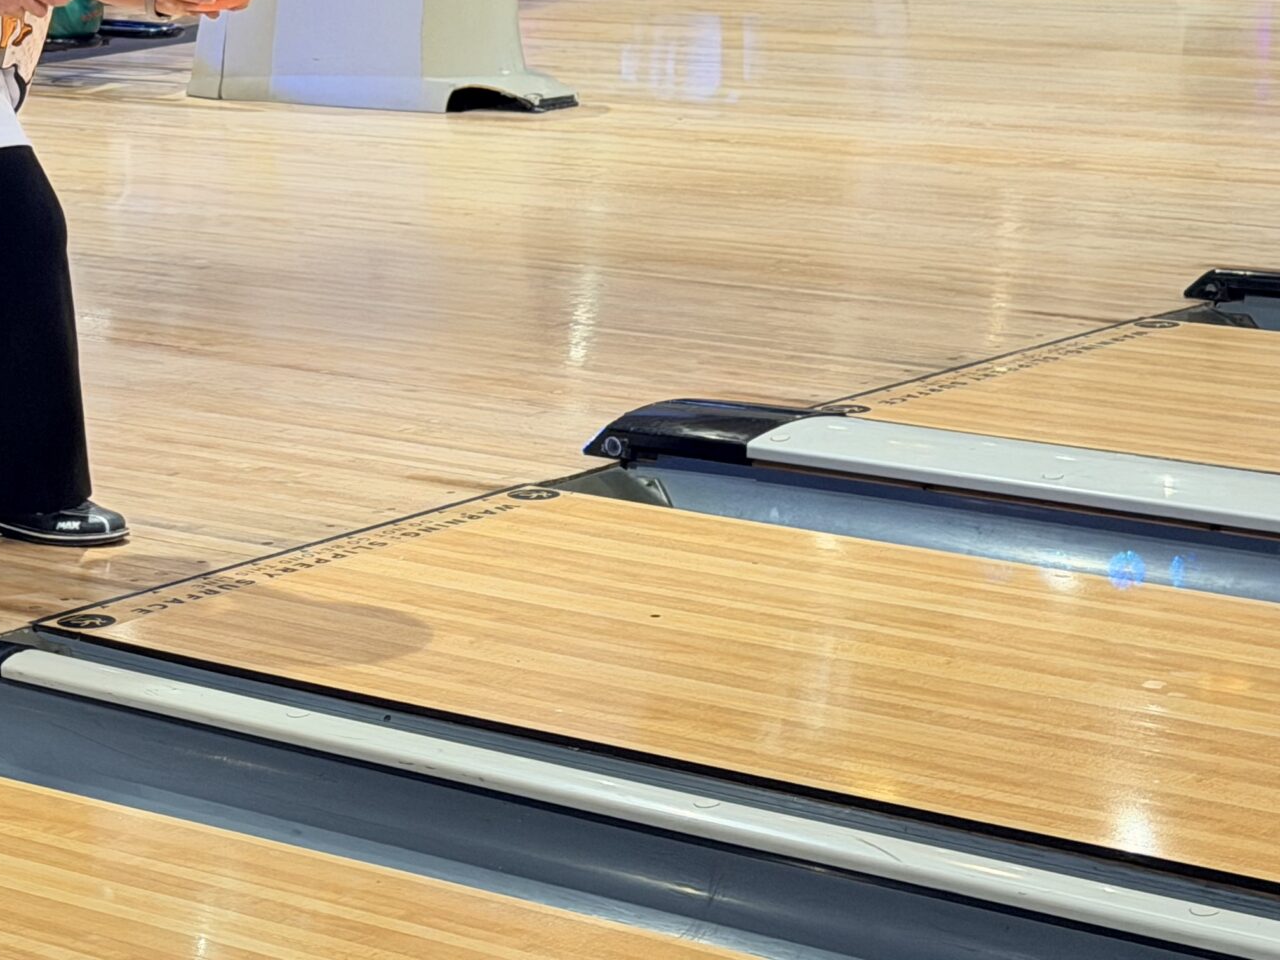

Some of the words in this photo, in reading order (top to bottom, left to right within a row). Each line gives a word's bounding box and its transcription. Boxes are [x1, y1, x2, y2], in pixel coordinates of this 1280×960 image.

[56, 520, 81, 530] MAX
[263, 540, 388, 579] SLIPPERY
[131, 578, 256, 615] SURFACE
